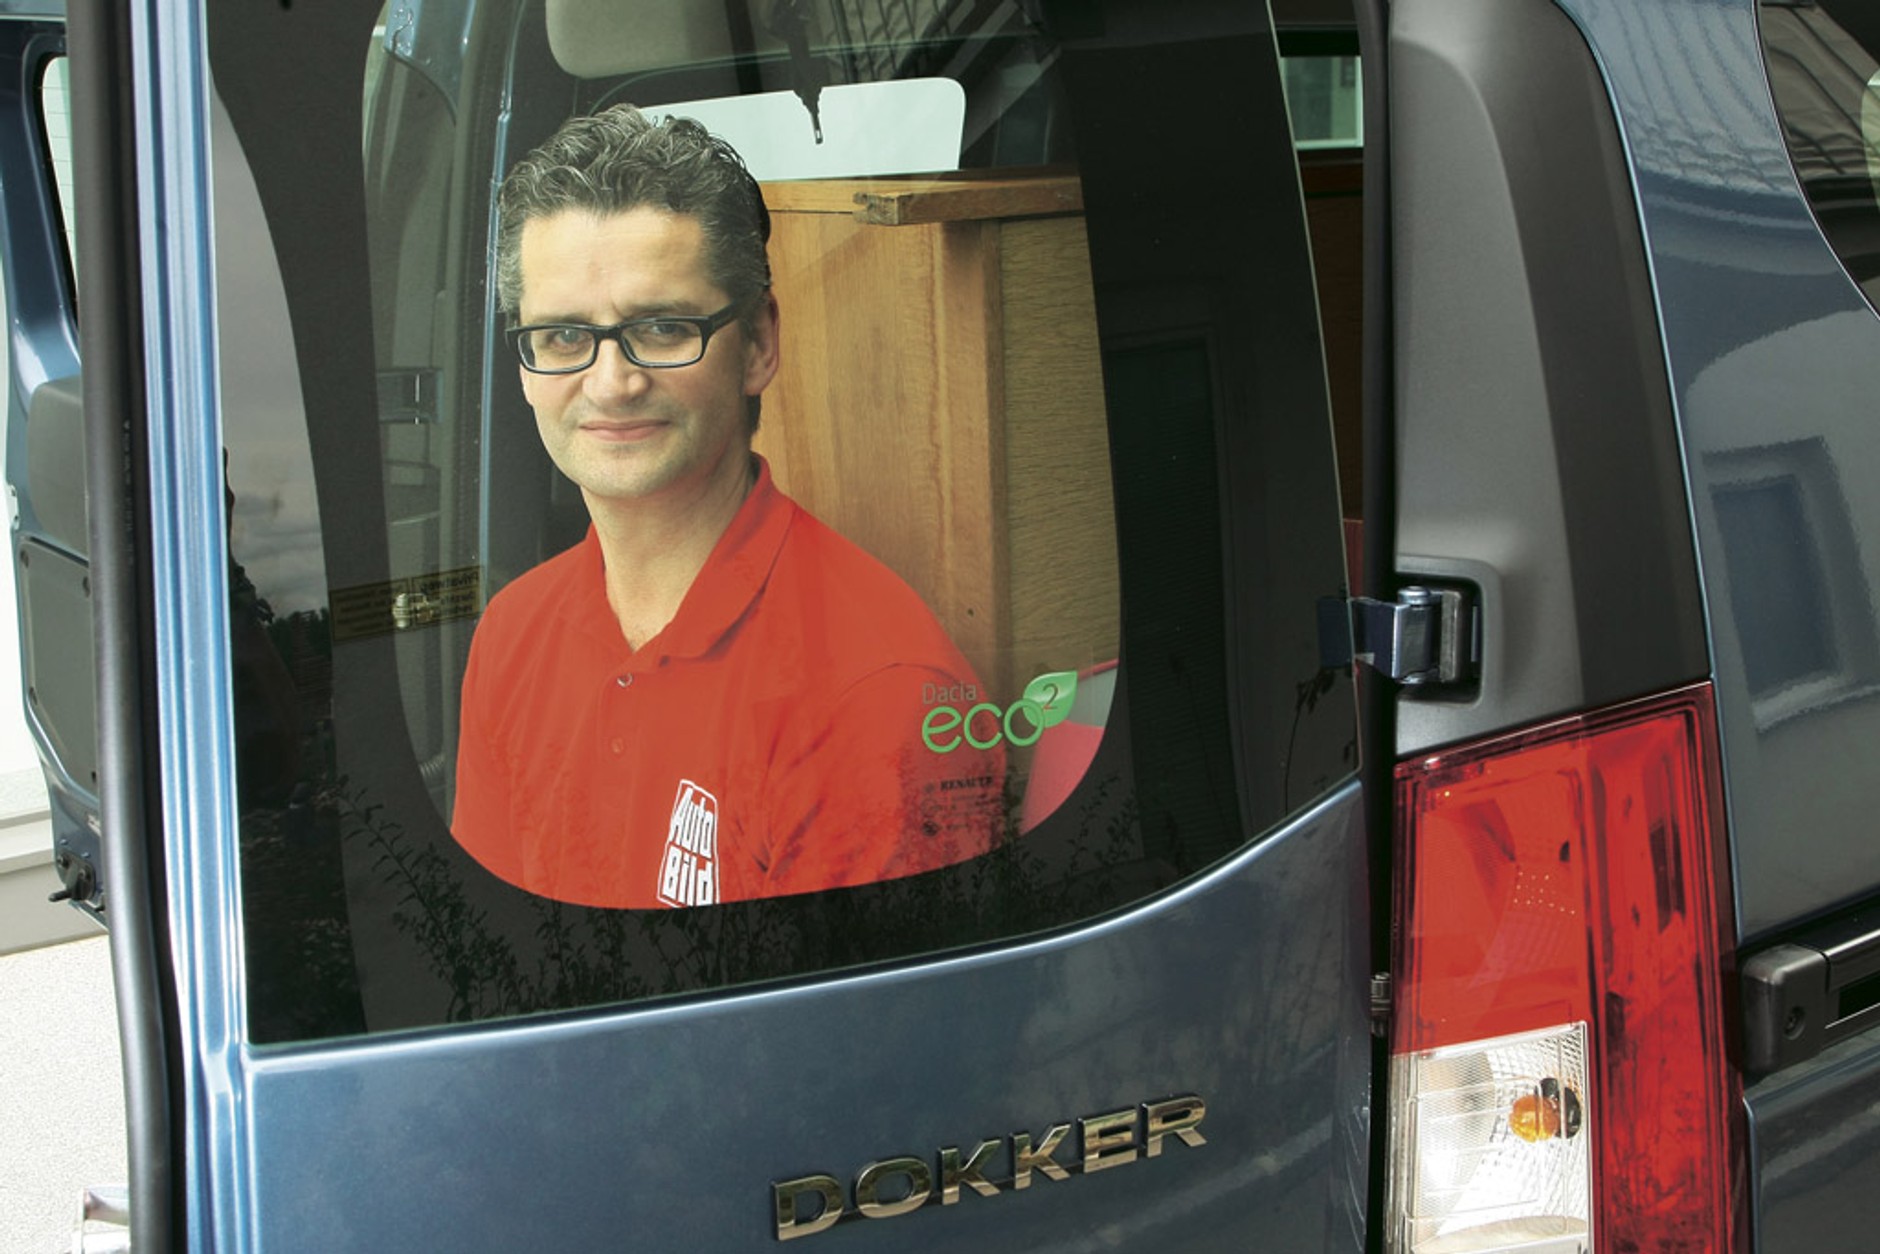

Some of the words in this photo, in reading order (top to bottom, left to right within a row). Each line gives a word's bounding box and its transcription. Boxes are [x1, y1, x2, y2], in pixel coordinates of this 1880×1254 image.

[922, 680, 977, 704] Dacia
[668, 787, 714, 859] Auto
[662, 846, 714, 906] Bild
[771, 1094, 1207, 1241] DOKKER
